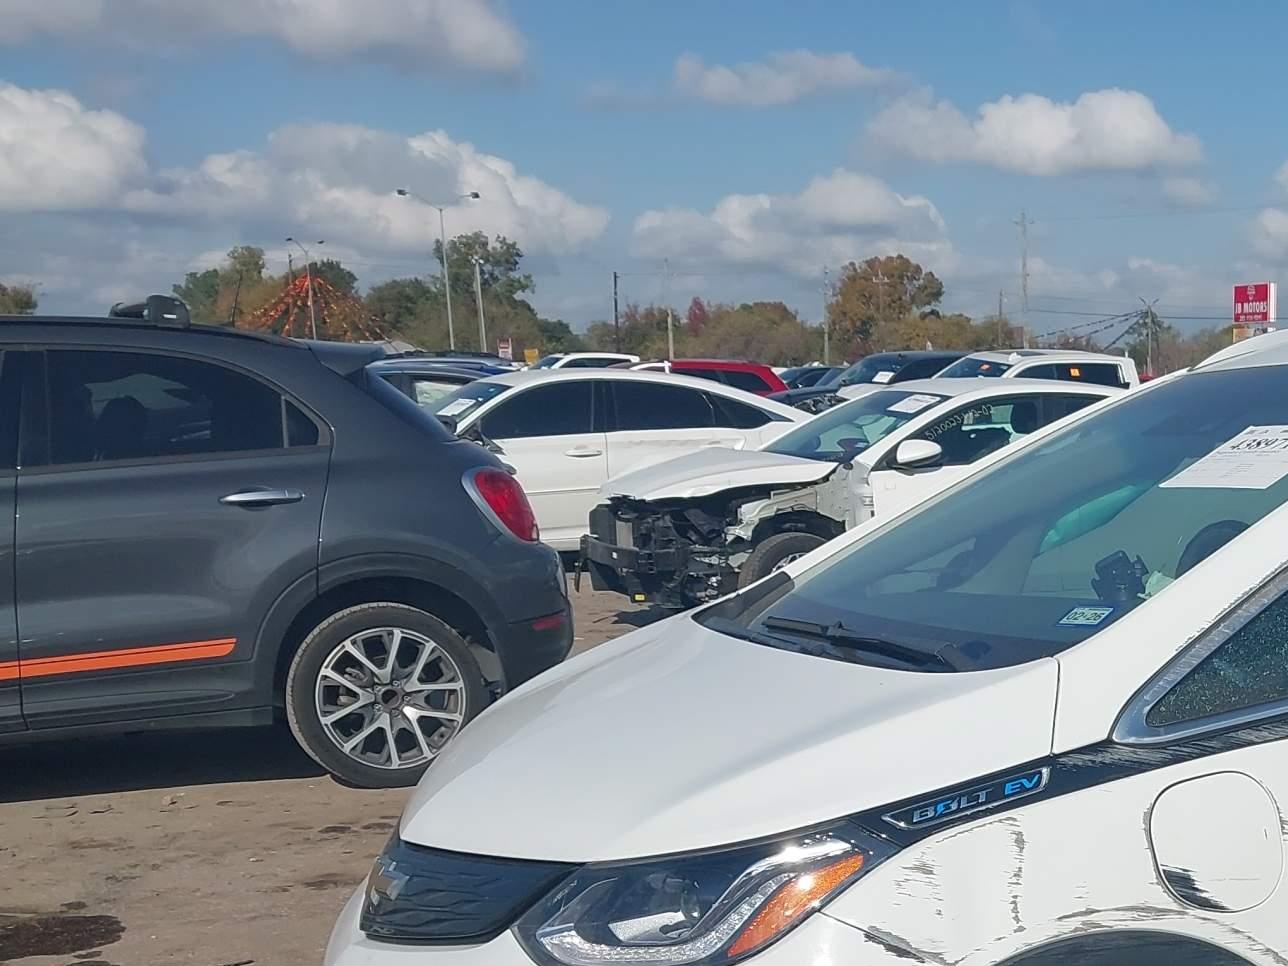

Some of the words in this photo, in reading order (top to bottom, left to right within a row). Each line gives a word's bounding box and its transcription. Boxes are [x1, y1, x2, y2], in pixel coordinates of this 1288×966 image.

[1243, 301, 1267, 313] MOTORS
[912, 788, 993, 823] BOLT
[1004, 774, 1040, 796] EV
